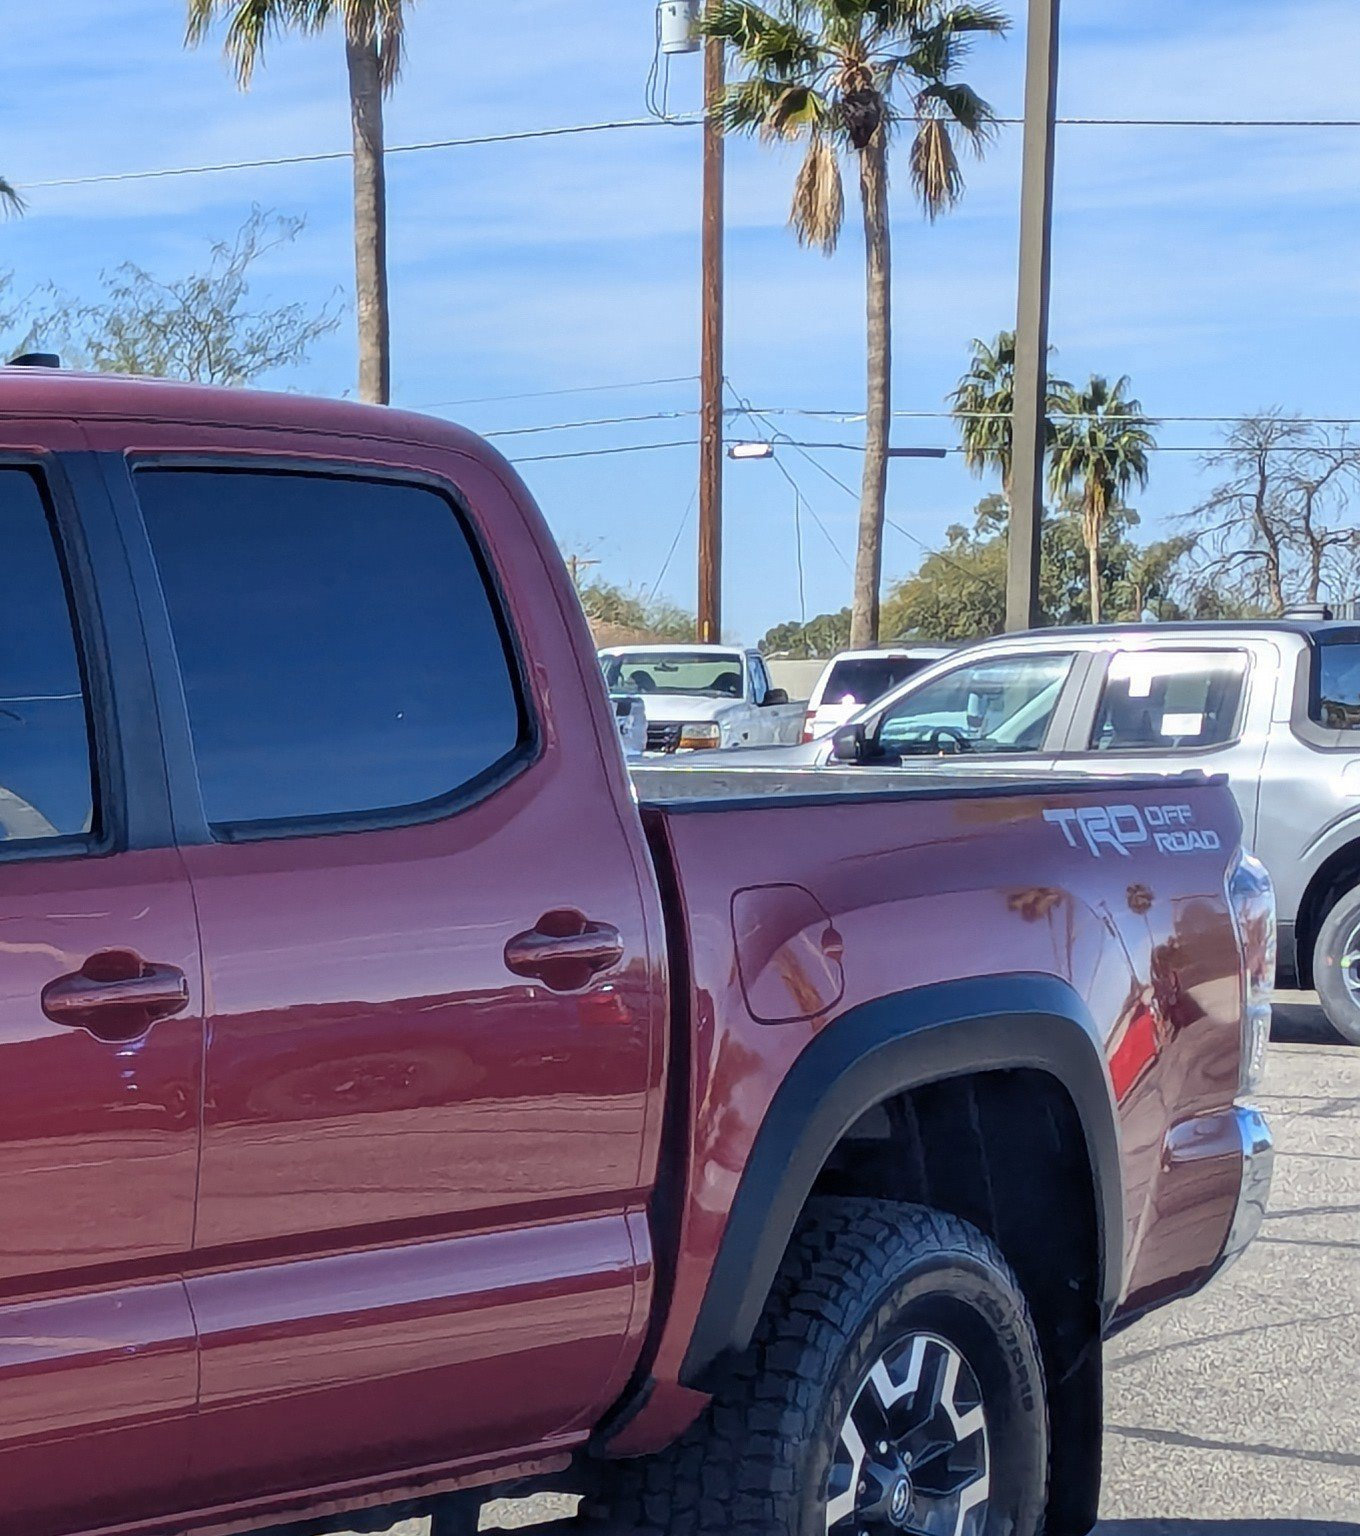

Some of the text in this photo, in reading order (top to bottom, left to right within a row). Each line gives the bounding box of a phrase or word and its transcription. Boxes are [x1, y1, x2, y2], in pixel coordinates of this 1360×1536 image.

[1144, 805, 1192, 826] OFF
[1043, 805, 1147, 857] TRD
[1153, 830, 1220, 853] ROAD
